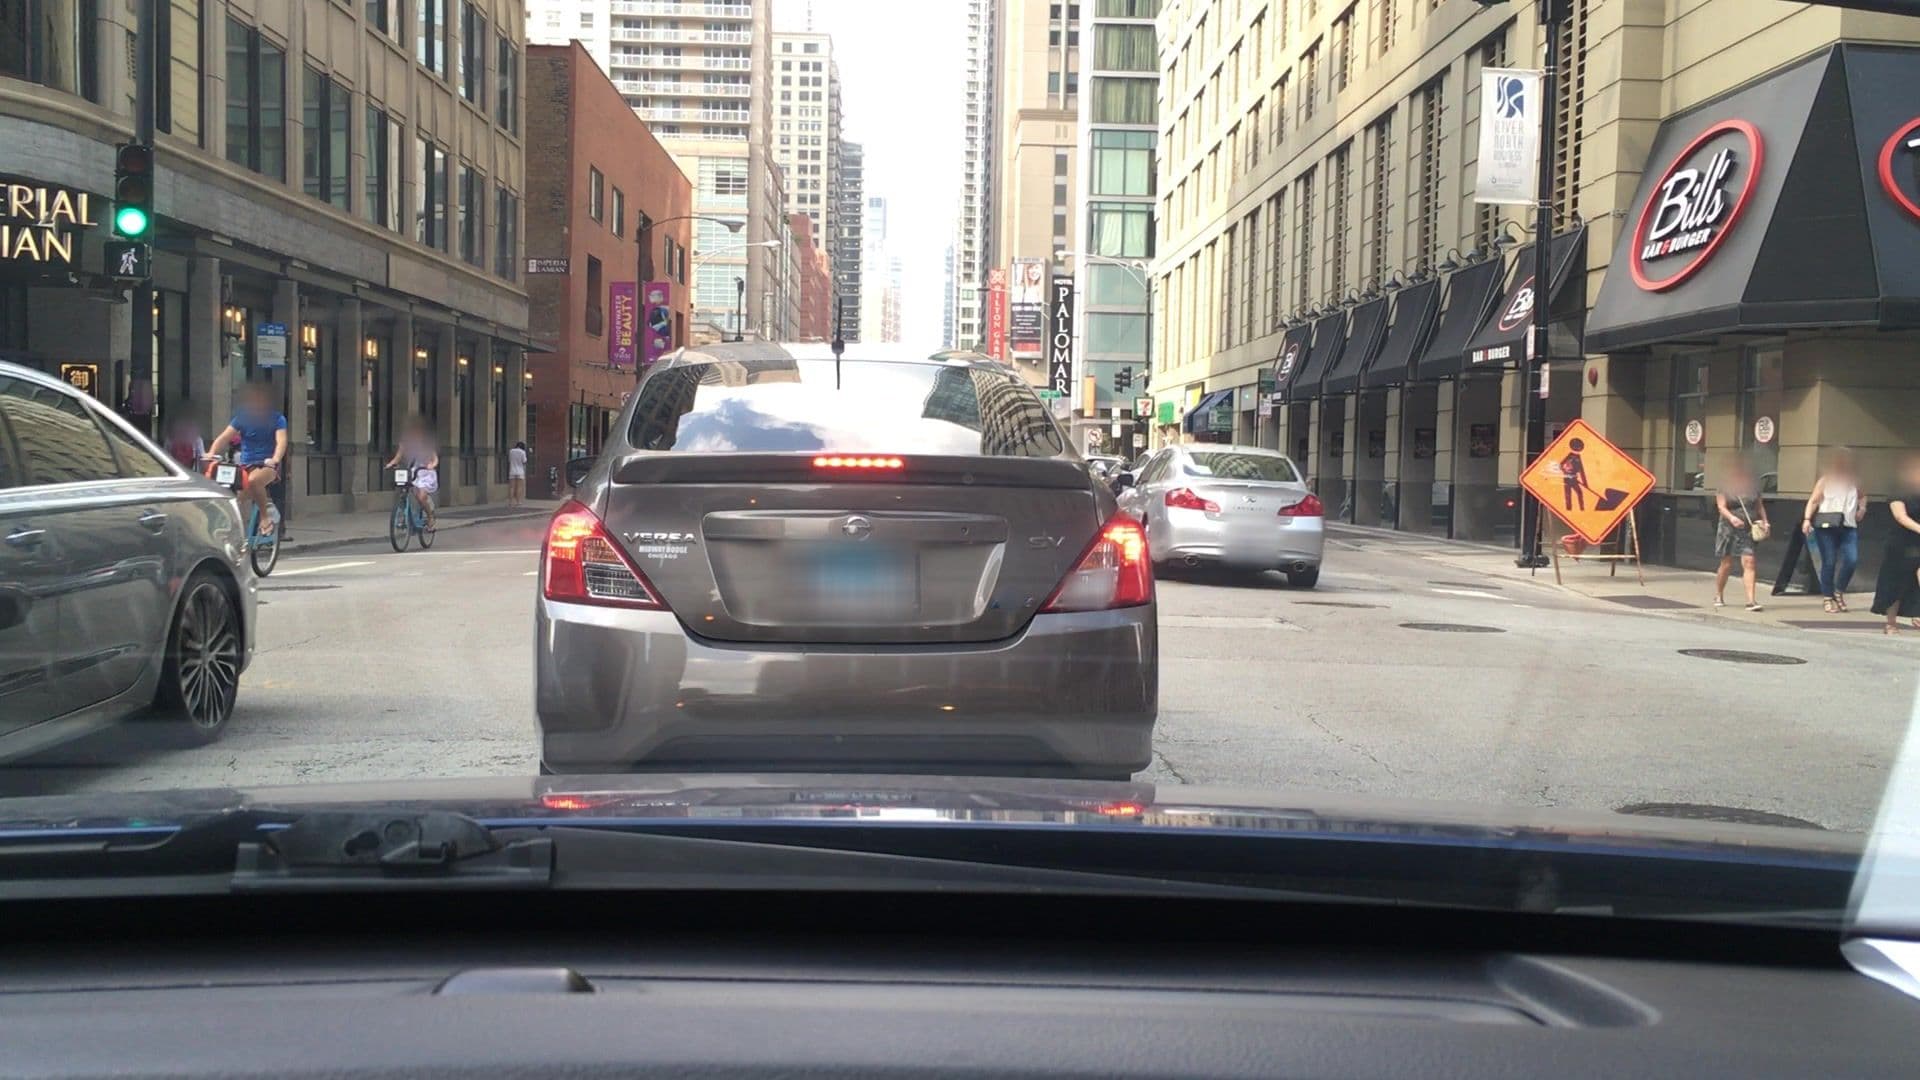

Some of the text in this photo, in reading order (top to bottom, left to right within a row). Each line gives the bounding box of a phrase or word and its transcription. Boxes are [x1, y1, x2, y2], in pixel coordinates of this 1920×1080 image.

[1649, 147, 1731, 241] Bill's
[621, 294, 633, 347] BEAUTY
[1052, 287, 1072, 394] PALOMAR
[623, 532, 697, 544] VERSA
